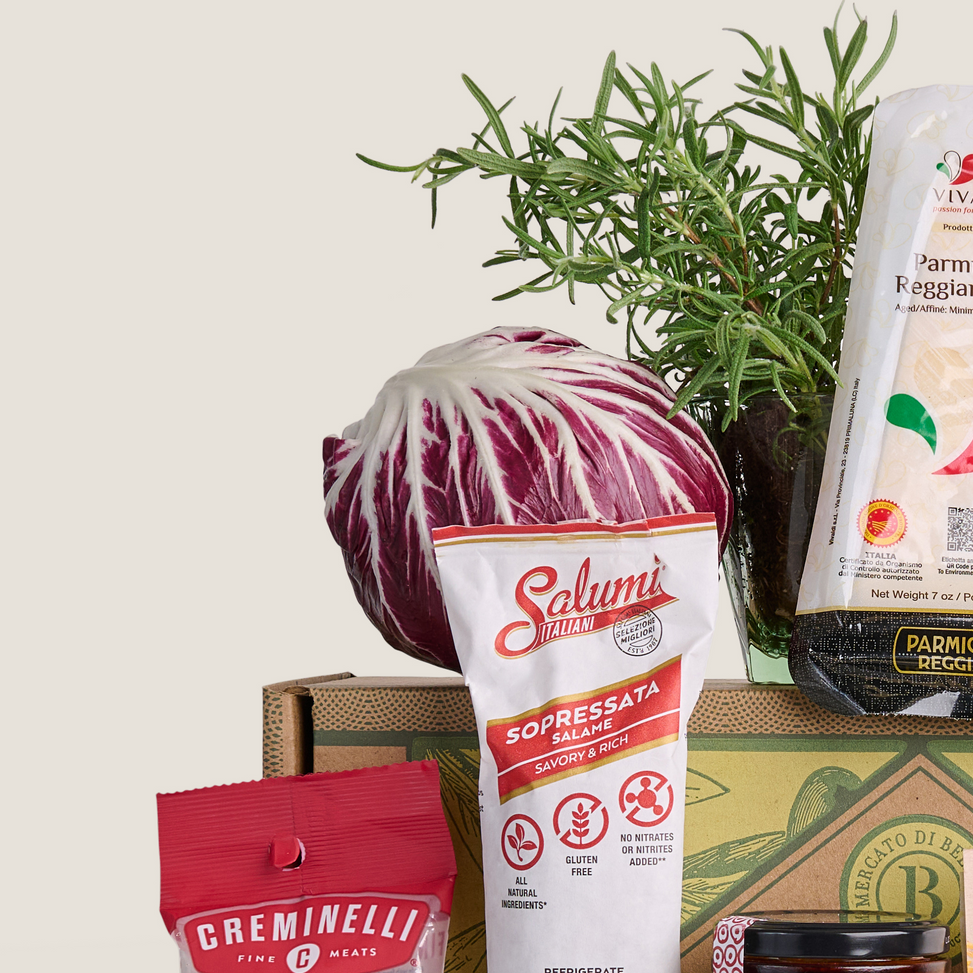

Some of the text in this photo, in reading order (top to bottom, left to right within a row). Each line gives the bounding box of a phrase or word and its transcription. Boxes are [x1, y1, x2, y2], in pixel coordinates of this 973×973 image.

[933, 206, 961, 215] passion
[871, 589, 889, 599] Net
[892, 590, 928, 602] Weight
[932, 591, 938, 599] 7
[495, 553, 666, 659] Salumi
[539, 617, 597, 644] ITALIANI
[505, 681, 660, 745] SOPRESSATA
[552, 718, 613, 744] SALAME
[535, 734, 629, 774] SAVORY & RICH
[620, 833, 674, 842] NO NITRATES
[622, 845, 673, 854] OR NITRITES
[566, 856, 598, 864] GLUTEN
[571, 868, 592, 876] FREE
[855, 830, 935, 908] MERCATO DI
[515, 877, 527, 885] ALL
[508, 889, 537, 897] NATURAL
[197, 904, 418, 950] CREMINELLI
[238, 948, 377, 963] FINE MEATS
